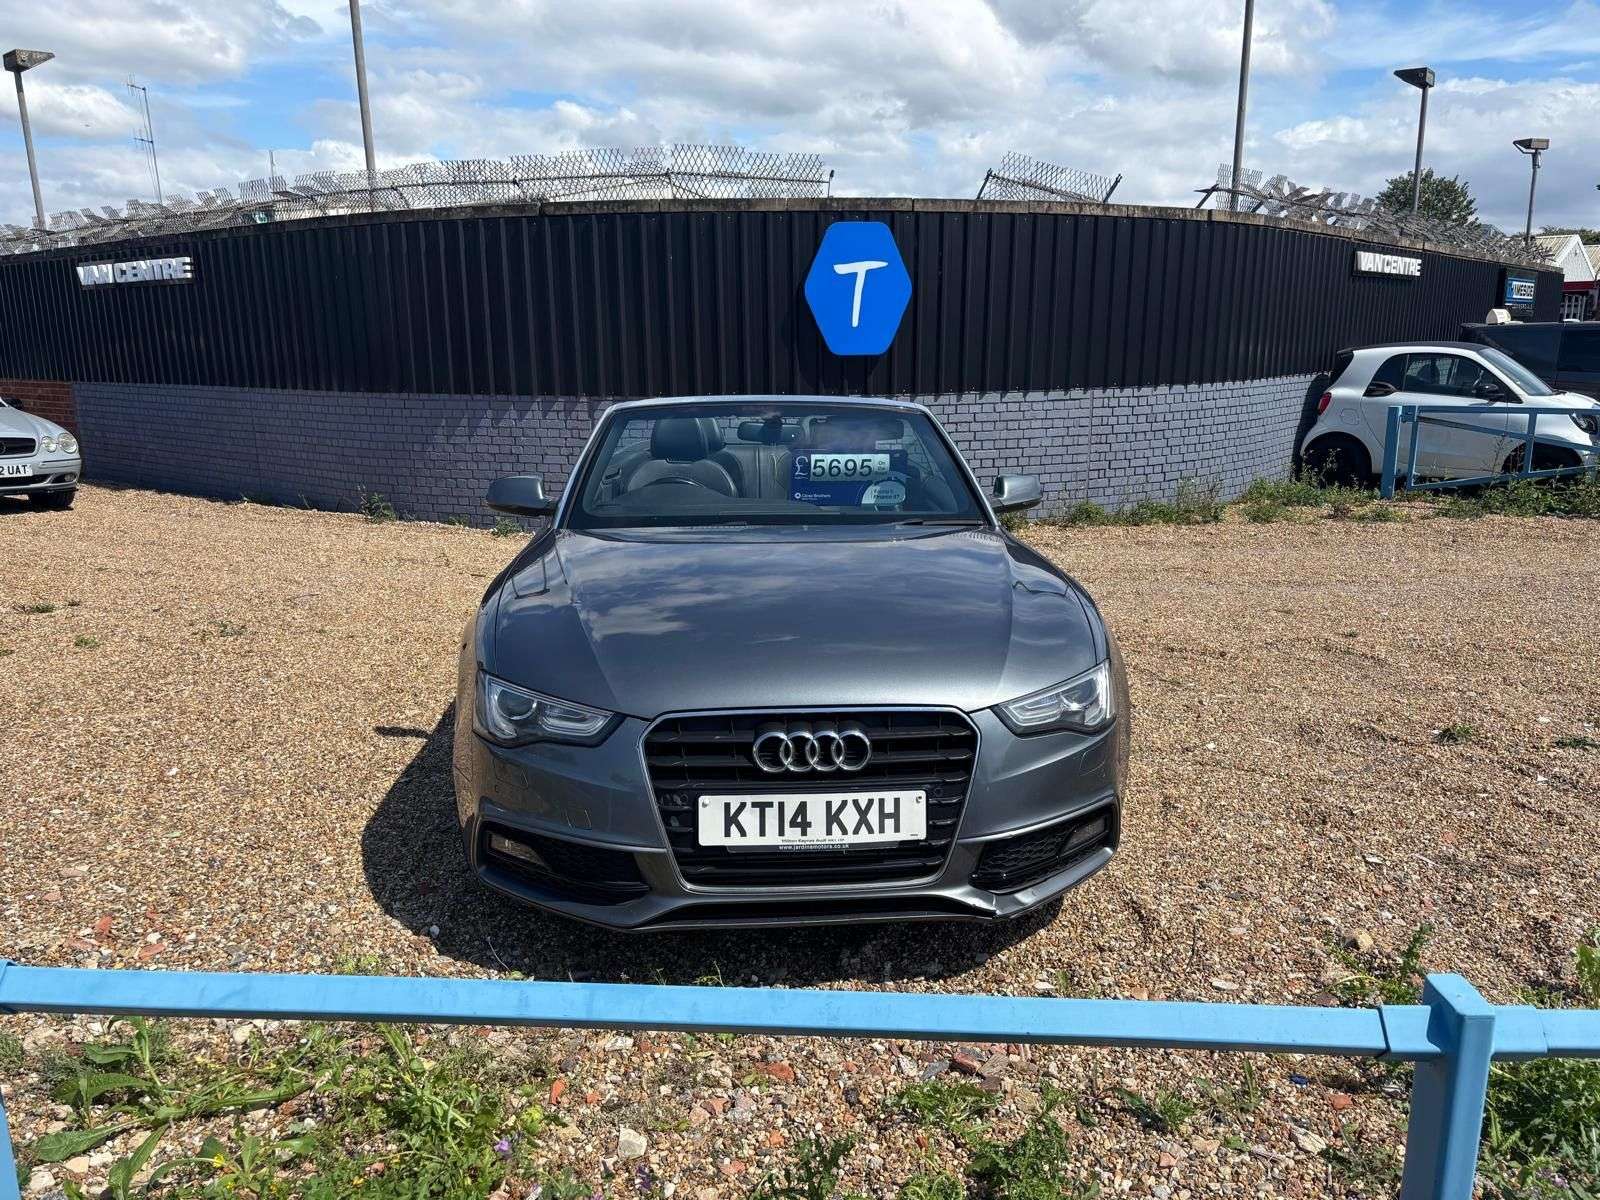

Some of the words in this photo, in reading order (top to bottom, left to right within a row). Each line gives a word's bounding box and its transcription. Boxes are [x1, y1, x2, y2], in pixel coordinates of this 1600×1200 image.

[76, 265, 112, 285] VAN
[113, 257, 192, 282] CENTRE
[1356, 251, 1382, 272] VAN
[1383, 255, 1422, 276] CENTRE
[833, 261, 889, 328] T
[7, 465, 27, 475] UAT
[723, 801, 812, 837] KT14
[825, 797, 900, 836] KXH
